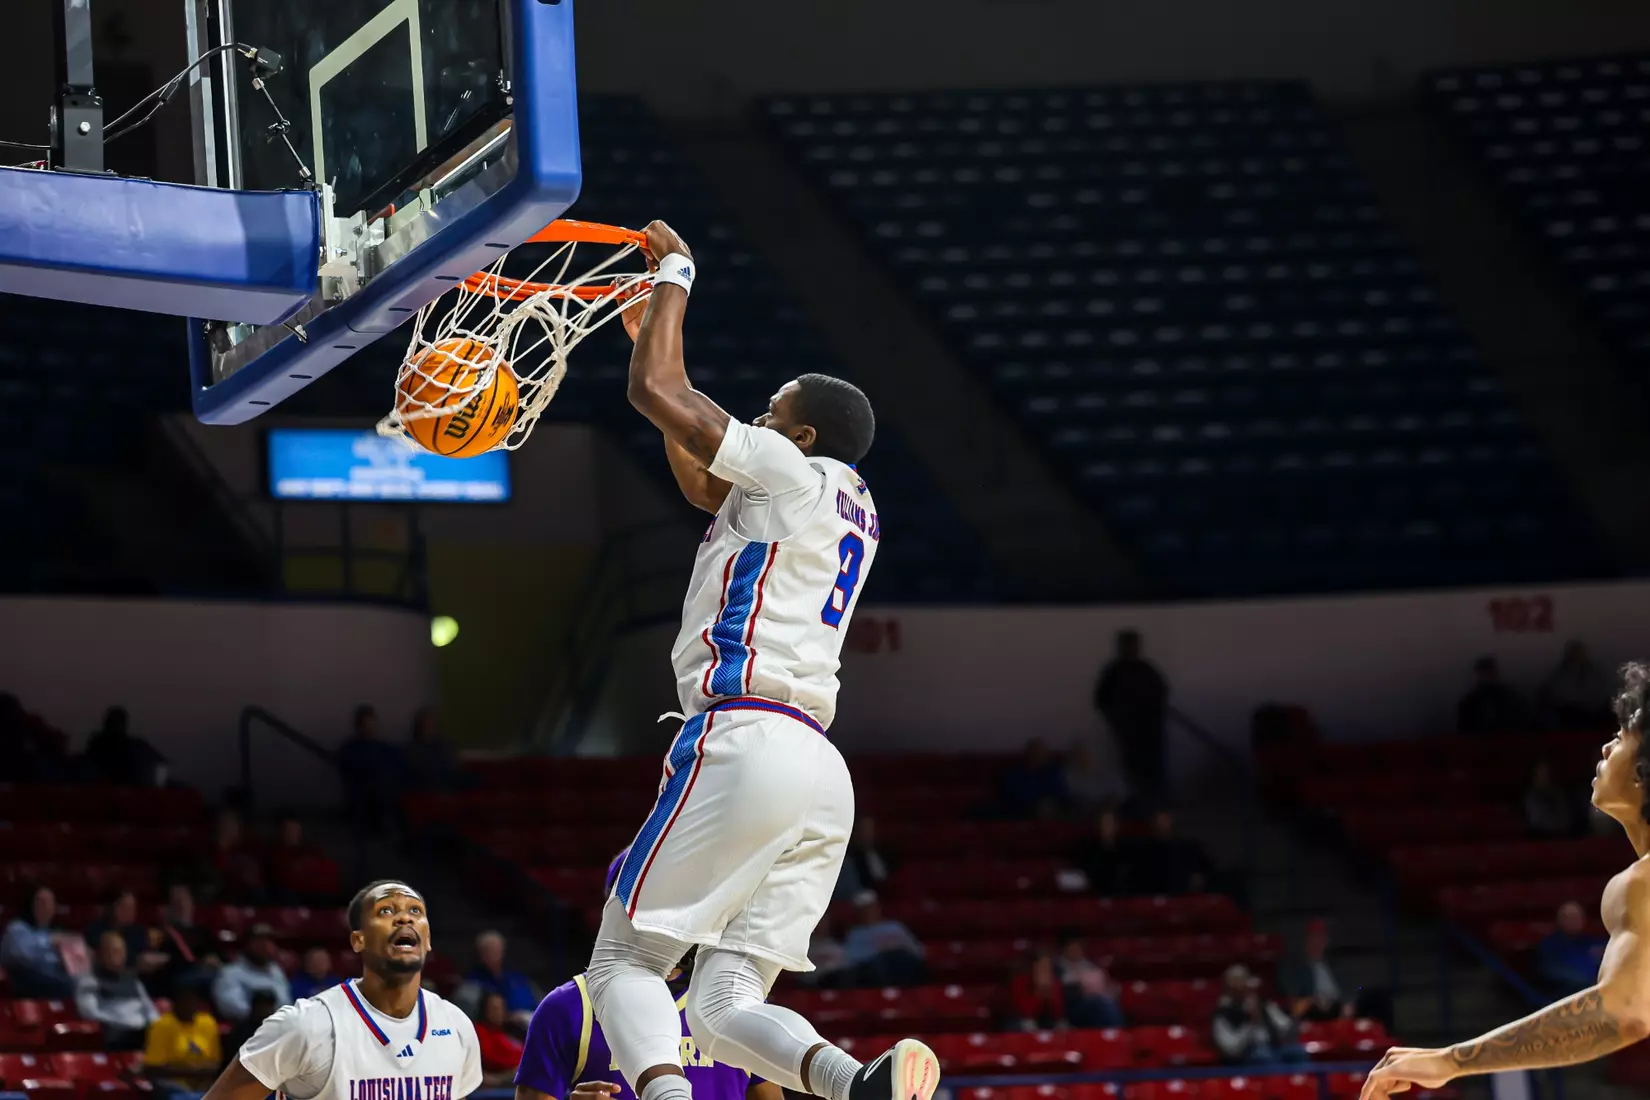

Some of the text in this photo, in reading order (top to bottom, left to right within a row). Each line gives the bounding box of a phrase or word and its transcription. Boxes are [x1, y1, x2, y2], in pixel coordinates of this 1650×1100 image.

[1487, 596, 1555, 634] 102
[350, 1075, 453, 1100] LOUISIANA TECH
